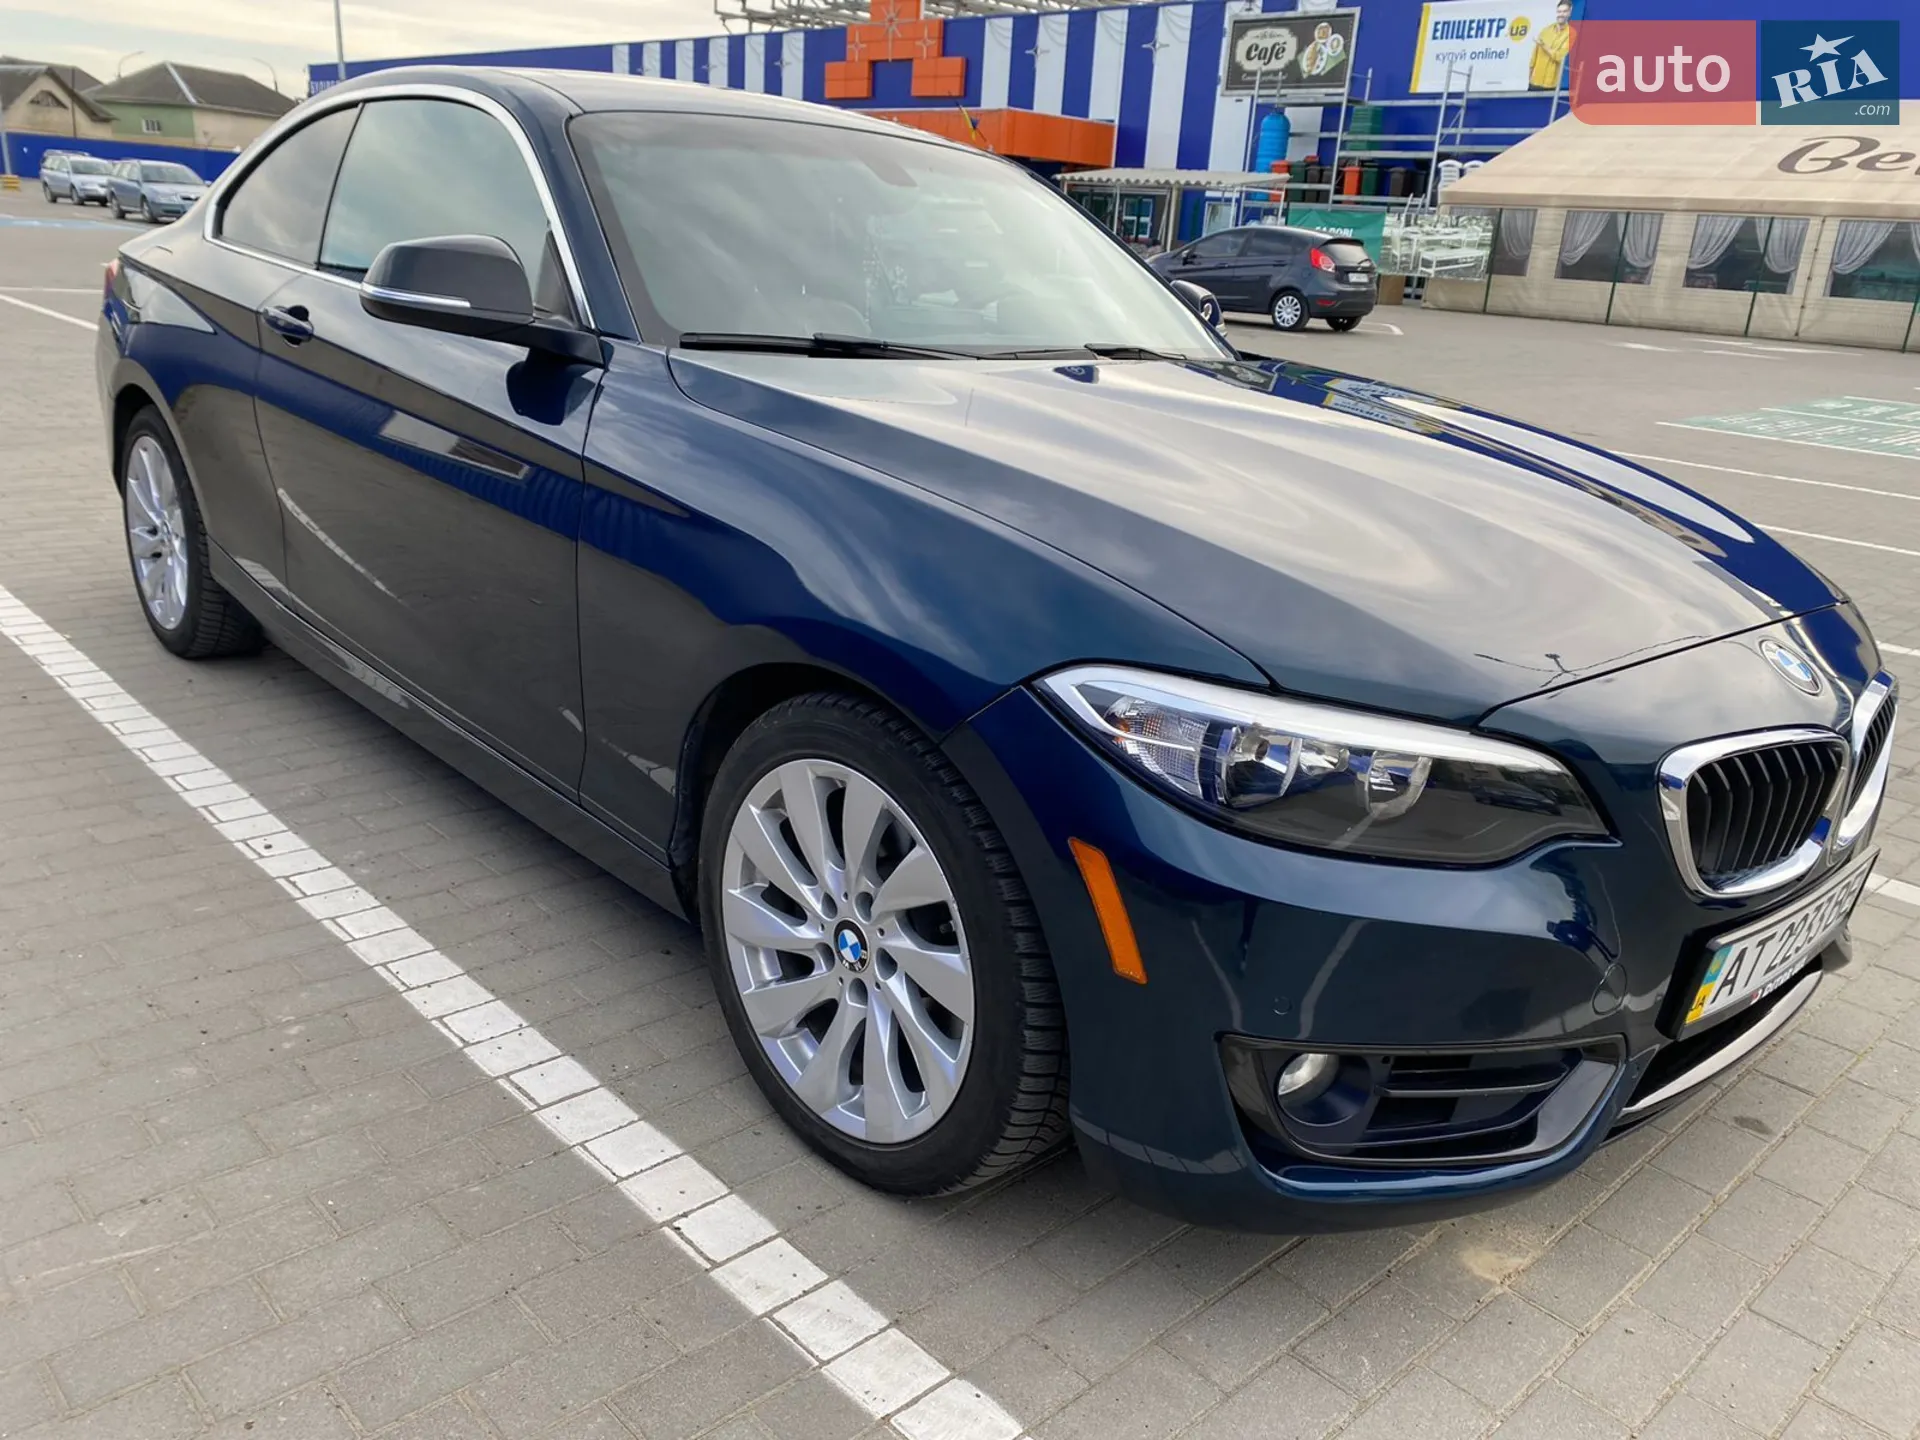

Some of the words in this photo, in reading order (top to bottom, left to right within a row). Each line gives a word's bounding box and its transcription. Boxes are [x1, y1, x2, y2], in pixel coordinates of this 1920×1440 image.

[1246, 41, 1288, 65] Café
[1469, 48, 1510, 60] online!
[1777, 135, 1920, 176] Be
